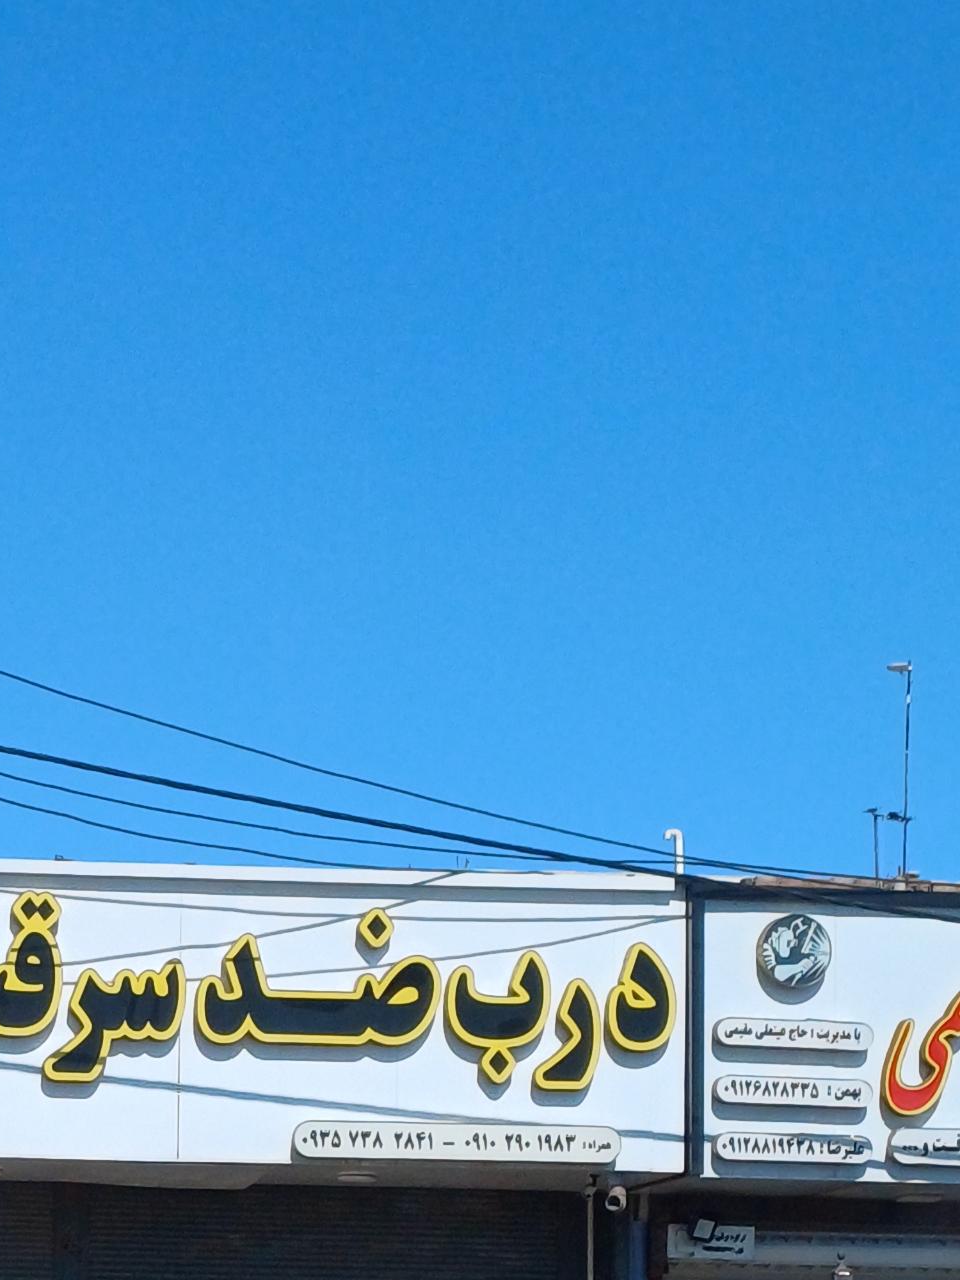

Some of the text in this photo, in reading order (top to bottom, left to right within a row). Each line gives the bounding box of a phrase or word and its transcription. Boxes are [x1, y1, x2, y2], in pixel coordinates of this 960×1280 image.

[195, 907, 442, 1046] ضد
[445, 941, 677, 1091] درب
[788, 1024, 808, 1041] حاج
[854, 1026, 861, 1044] با
